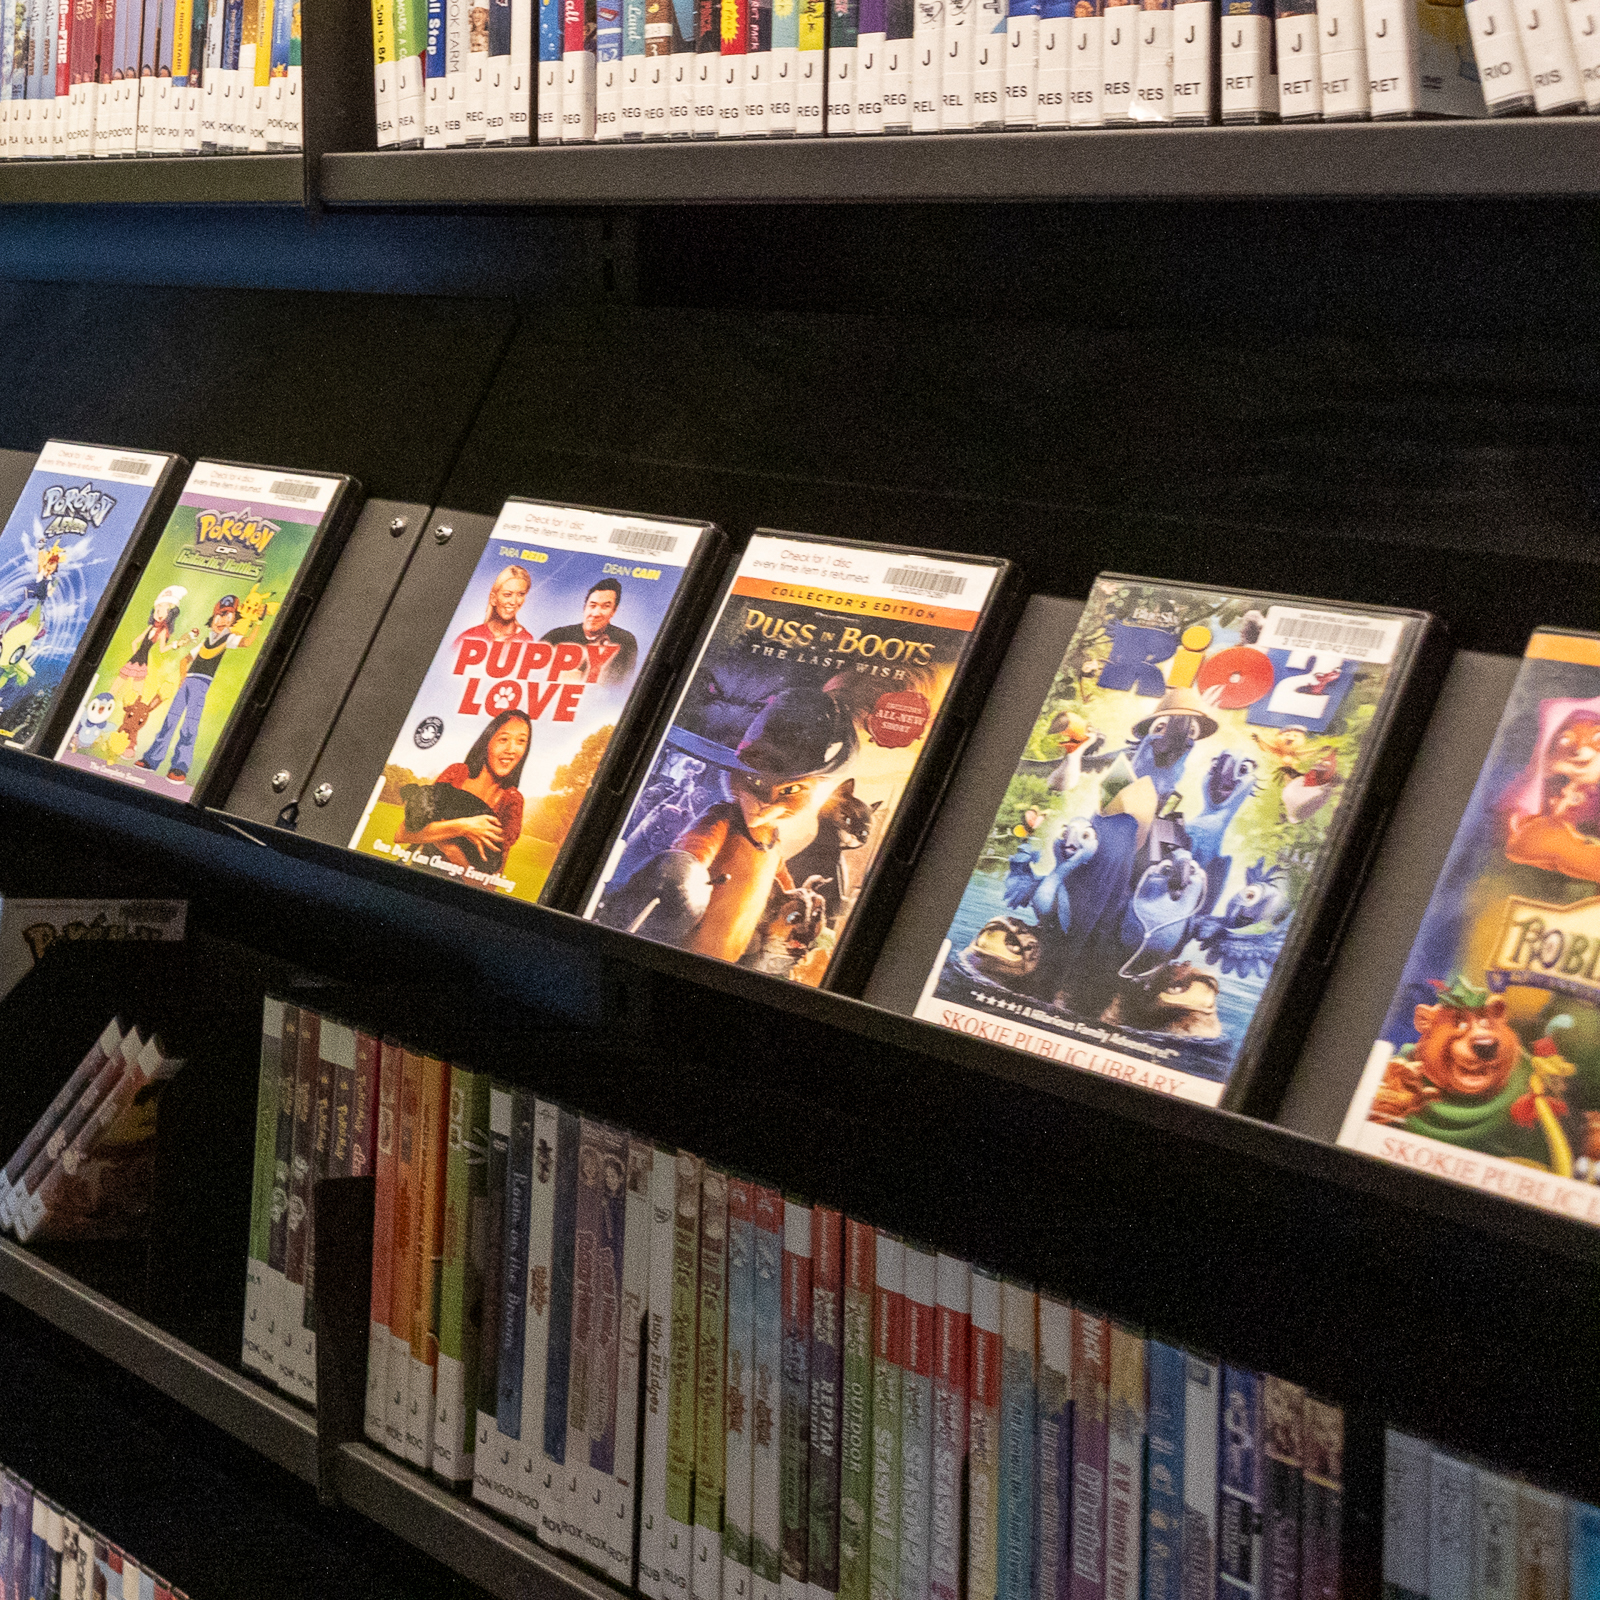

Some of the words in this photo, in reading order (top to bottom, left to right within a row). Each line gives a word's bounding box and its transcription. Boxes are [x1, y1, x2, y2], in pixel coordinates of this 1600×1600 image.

[428, 18, 440, 56] Step
[57, 30, 69, 64] FIRE
[450, 26, 460, 74] FARM
[1484, 62, 1512, 80] RIO
[1534, 70, 1561, 86] RIS
[1104, 82, 1131, 95] RES
[1174, 82, 1201, 96] RET
[1226, 75, 1254, 90] RET
[1283, 79, 1312, 95] RET
[1370, 78, 1399, 92] RET
[883, 93, 907, 105] REG
[943, 94, 963, 107] REL
[974, 92, 998, 104] RES
[1038, 93, 1063, 105] RES
[798, 106, 819, 117] REG
[828, 104, 850, 115] REG
[858, 102, 882, 114] REG
[913, 101, 936, 113] REL
[500, 546, 519, 558] TARA
[521, 550, 548, 563] REID
[781, 550, 810, 563] Check
[812, 554, 823, 565] for
[831, 557, 852, 569] disc
[603, 563, 631, 576] DEAN
[632, 568, 661, 580] CAIN
[753, 559, 777, 573] every
[779, 561, 797, 573] time
[799, 564, 819, 576] item
[829, 569, 870, 584] returned.
[771, 586, 868, 609] COLLECTOR'S
[874, 601, 937, 620] EDITION
[745, 609, 817, 647] PUSS
[821, 631, 836, 642] IN
[837, 626, 936, 666] BOOTS
[453, 639, 620, 683] PUPPY
[751, 644, 787, 660] THE
[797, 653, 846, 670] LAST
[856, 663, 907, 681] WISH
[1267, 648, 1345, 718] 2
[458, 677, 585, 722] LOVE
[875, 709, 926, 725] ALL-NEW
[373, 839, 391, 851] One
[412, 849, 429, 865] Can
[430, 855, 465, 876] Change
[465, 866, 516, 892] Everything
[941, 1009, 1012, 1044] SKOKIE
[1013, 1031, 1088, 1066] PUBLIC
[1088, 1052, 1185, 1095] LIBRARY
[1382, 1137, 1476, 1179] SKOKIE
[1480, 1167, 1580, 1211] PUBLIC
[850, 1382, 865, 1472] OUTDOOR
